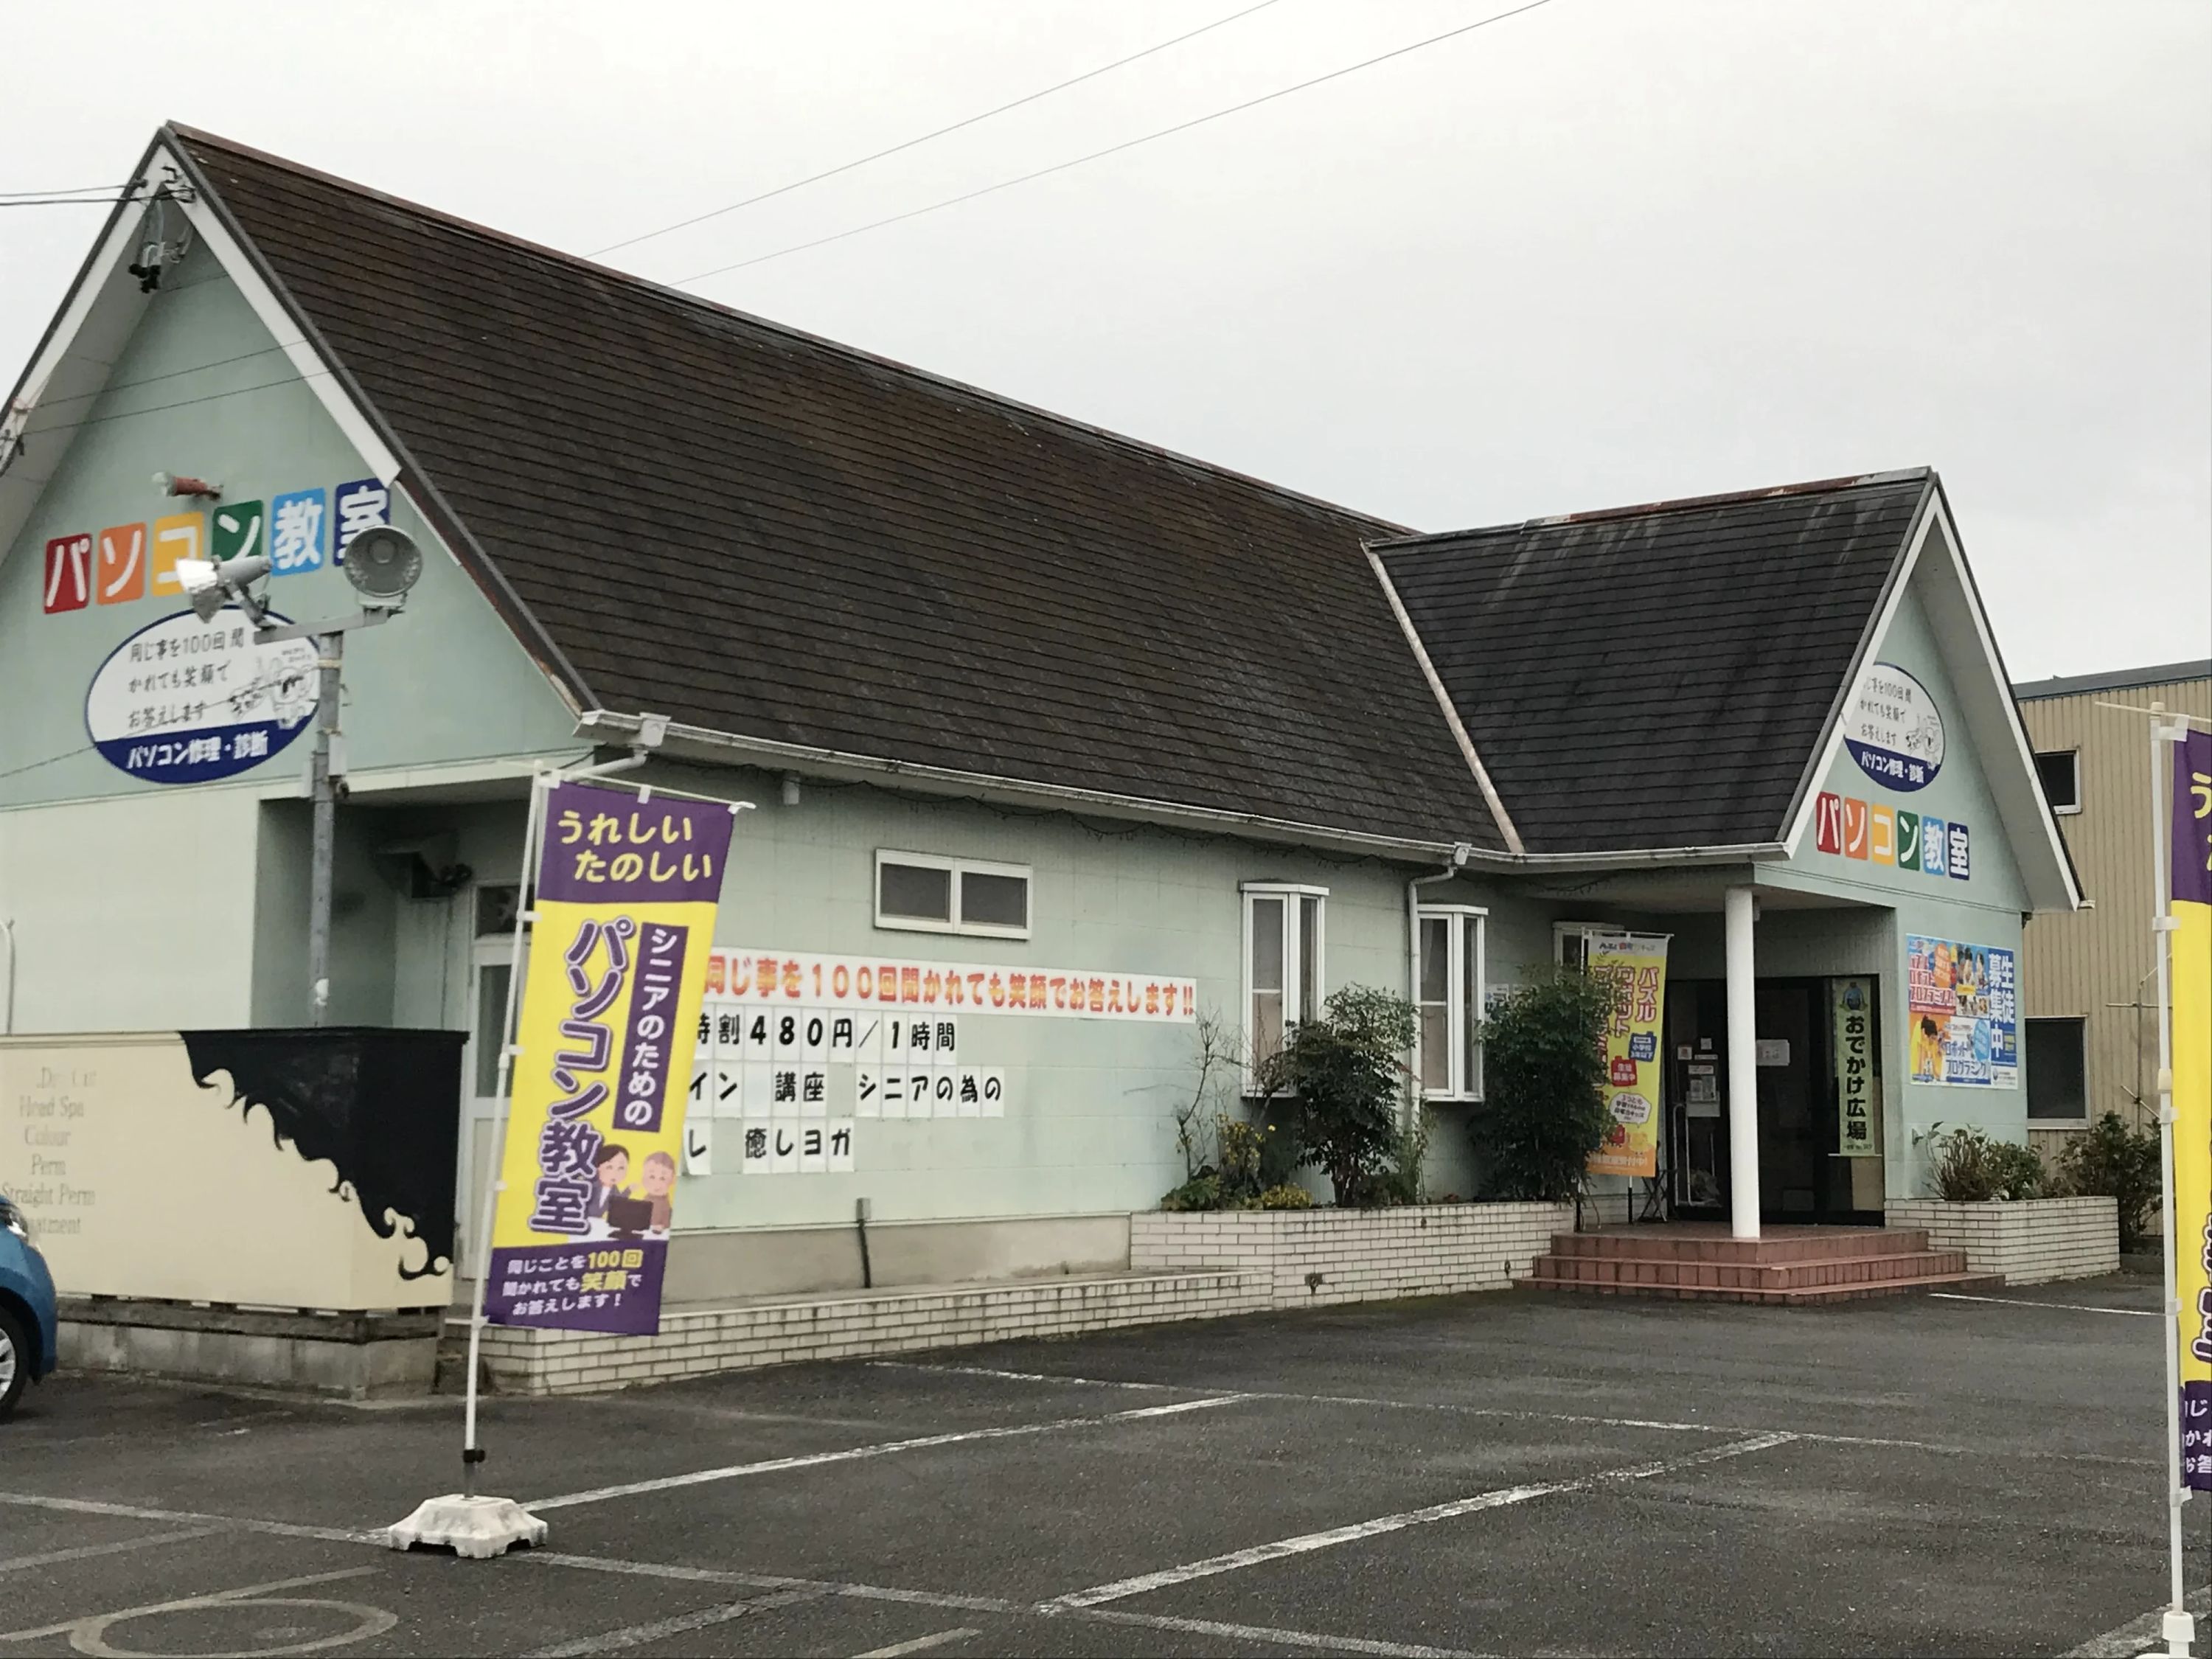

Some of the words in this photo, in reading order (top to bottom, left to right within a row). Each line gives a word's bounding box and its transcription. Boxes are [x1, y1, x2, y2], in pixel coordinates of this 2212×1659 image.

[557, 810, 692, 846] うれしい
[1818, 797, 1969, 876] パソコン教室
[574, 849, 713, 883] たのしい
[1635, 967, 1659, 1023] パズル
[625, 928, 678, 1126] シニアのための
[529, 916, 636, 1235] パソコン教室
[775, 1071, 825, 1103] 講座
[858, 1073, 1001, 1104] シニアの為の
[1845, 1015, 1867, 1141] おでかけ広場
[60, 1096, 84, 1119] Spa
[745, 1127, 852, 1159] 癒しヨガ
[31, 1153, 66, 1175] Perm
[59, 1183, 96, 1206] Perm
[507, 1249, 643, 1274] 同じことを100回
[502, 1270, 642, 1296] 聞かれても笑顔で
[512, 1293, 622, 1315] お答えします！
